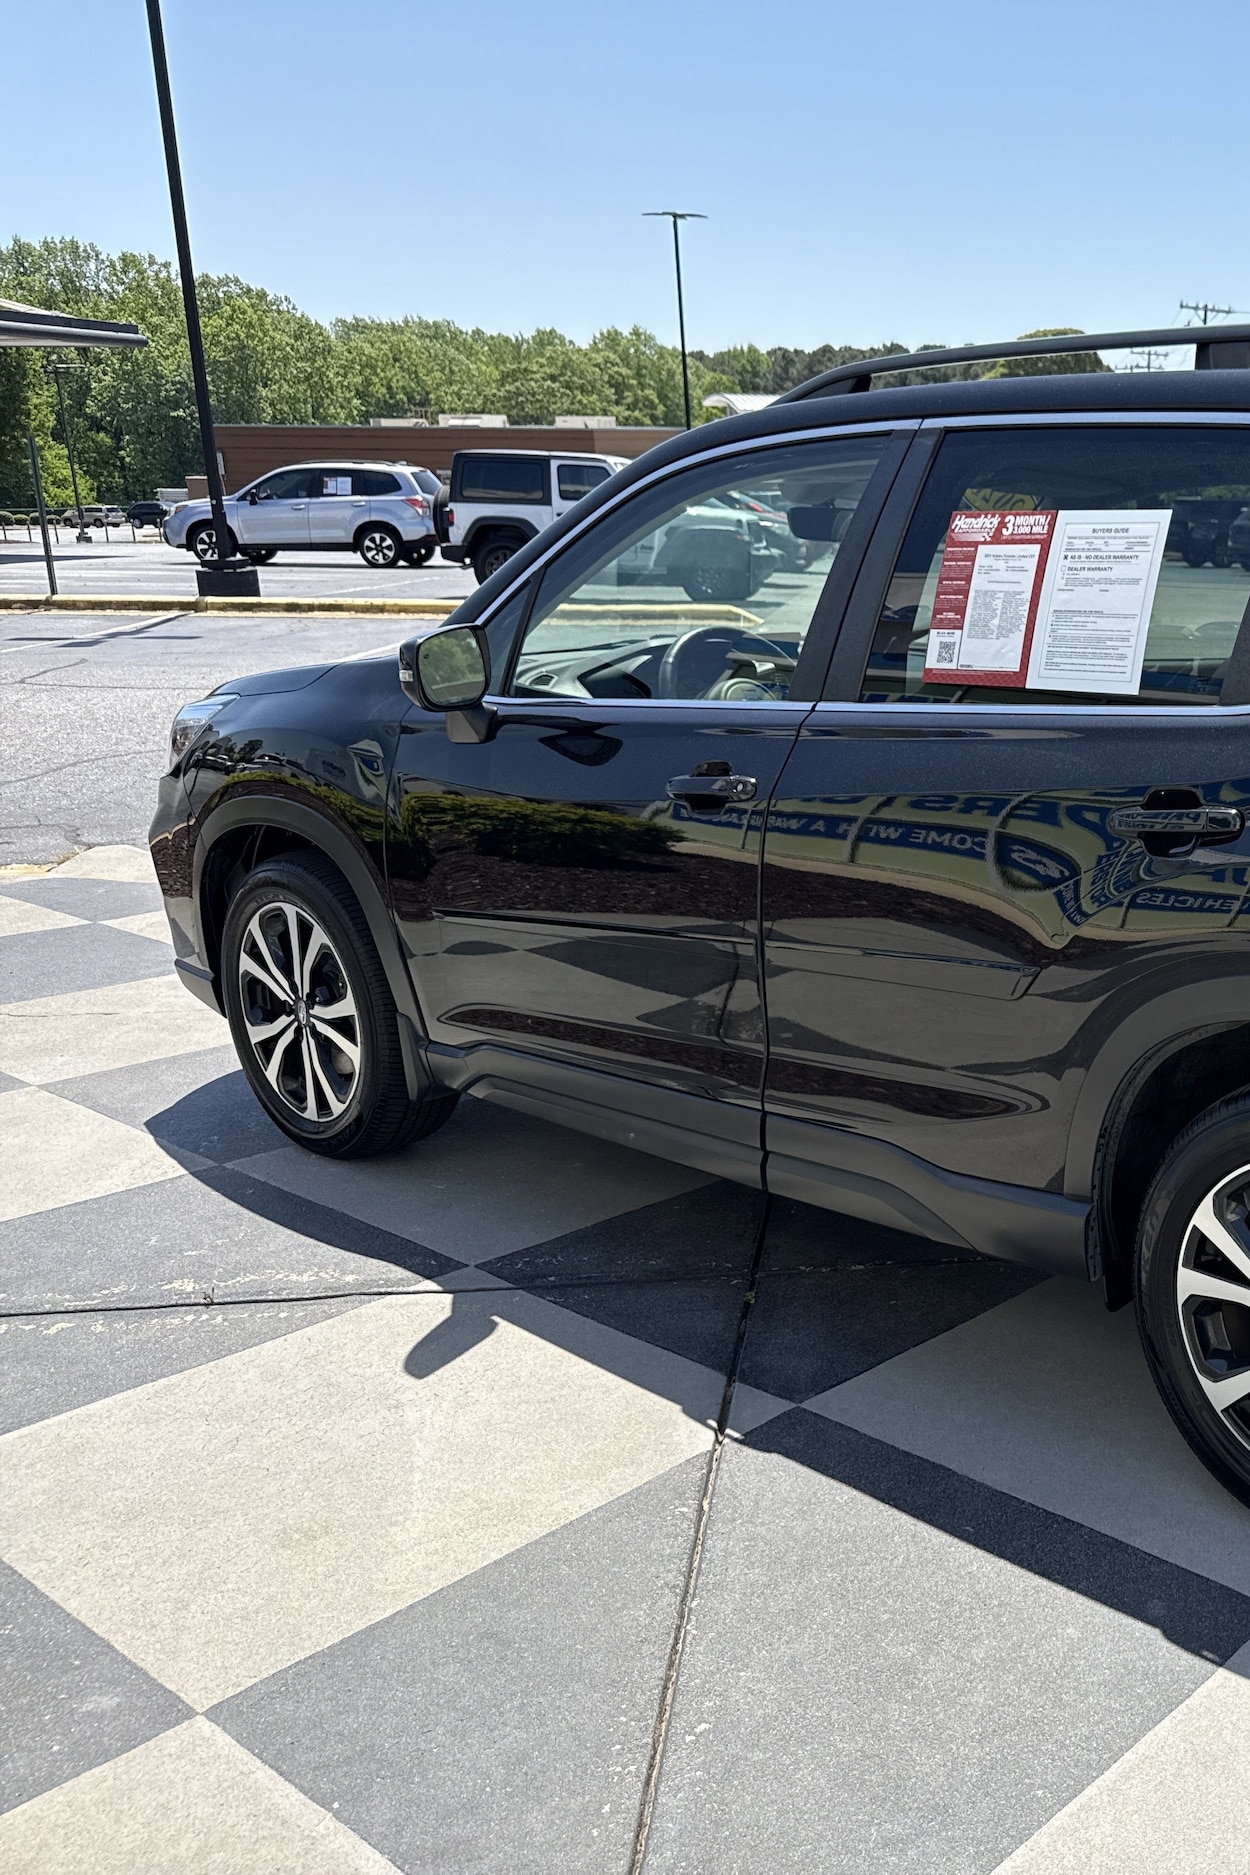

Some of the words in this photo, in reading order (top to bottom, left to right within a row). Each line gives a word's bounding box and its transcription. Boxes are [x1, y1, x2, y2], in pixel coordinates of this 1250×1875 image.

[951, 514, 1001, 534] Hendrick
[1001, 515, 1015, 536] 3
[1031, 525, 1049, 534] MILE
